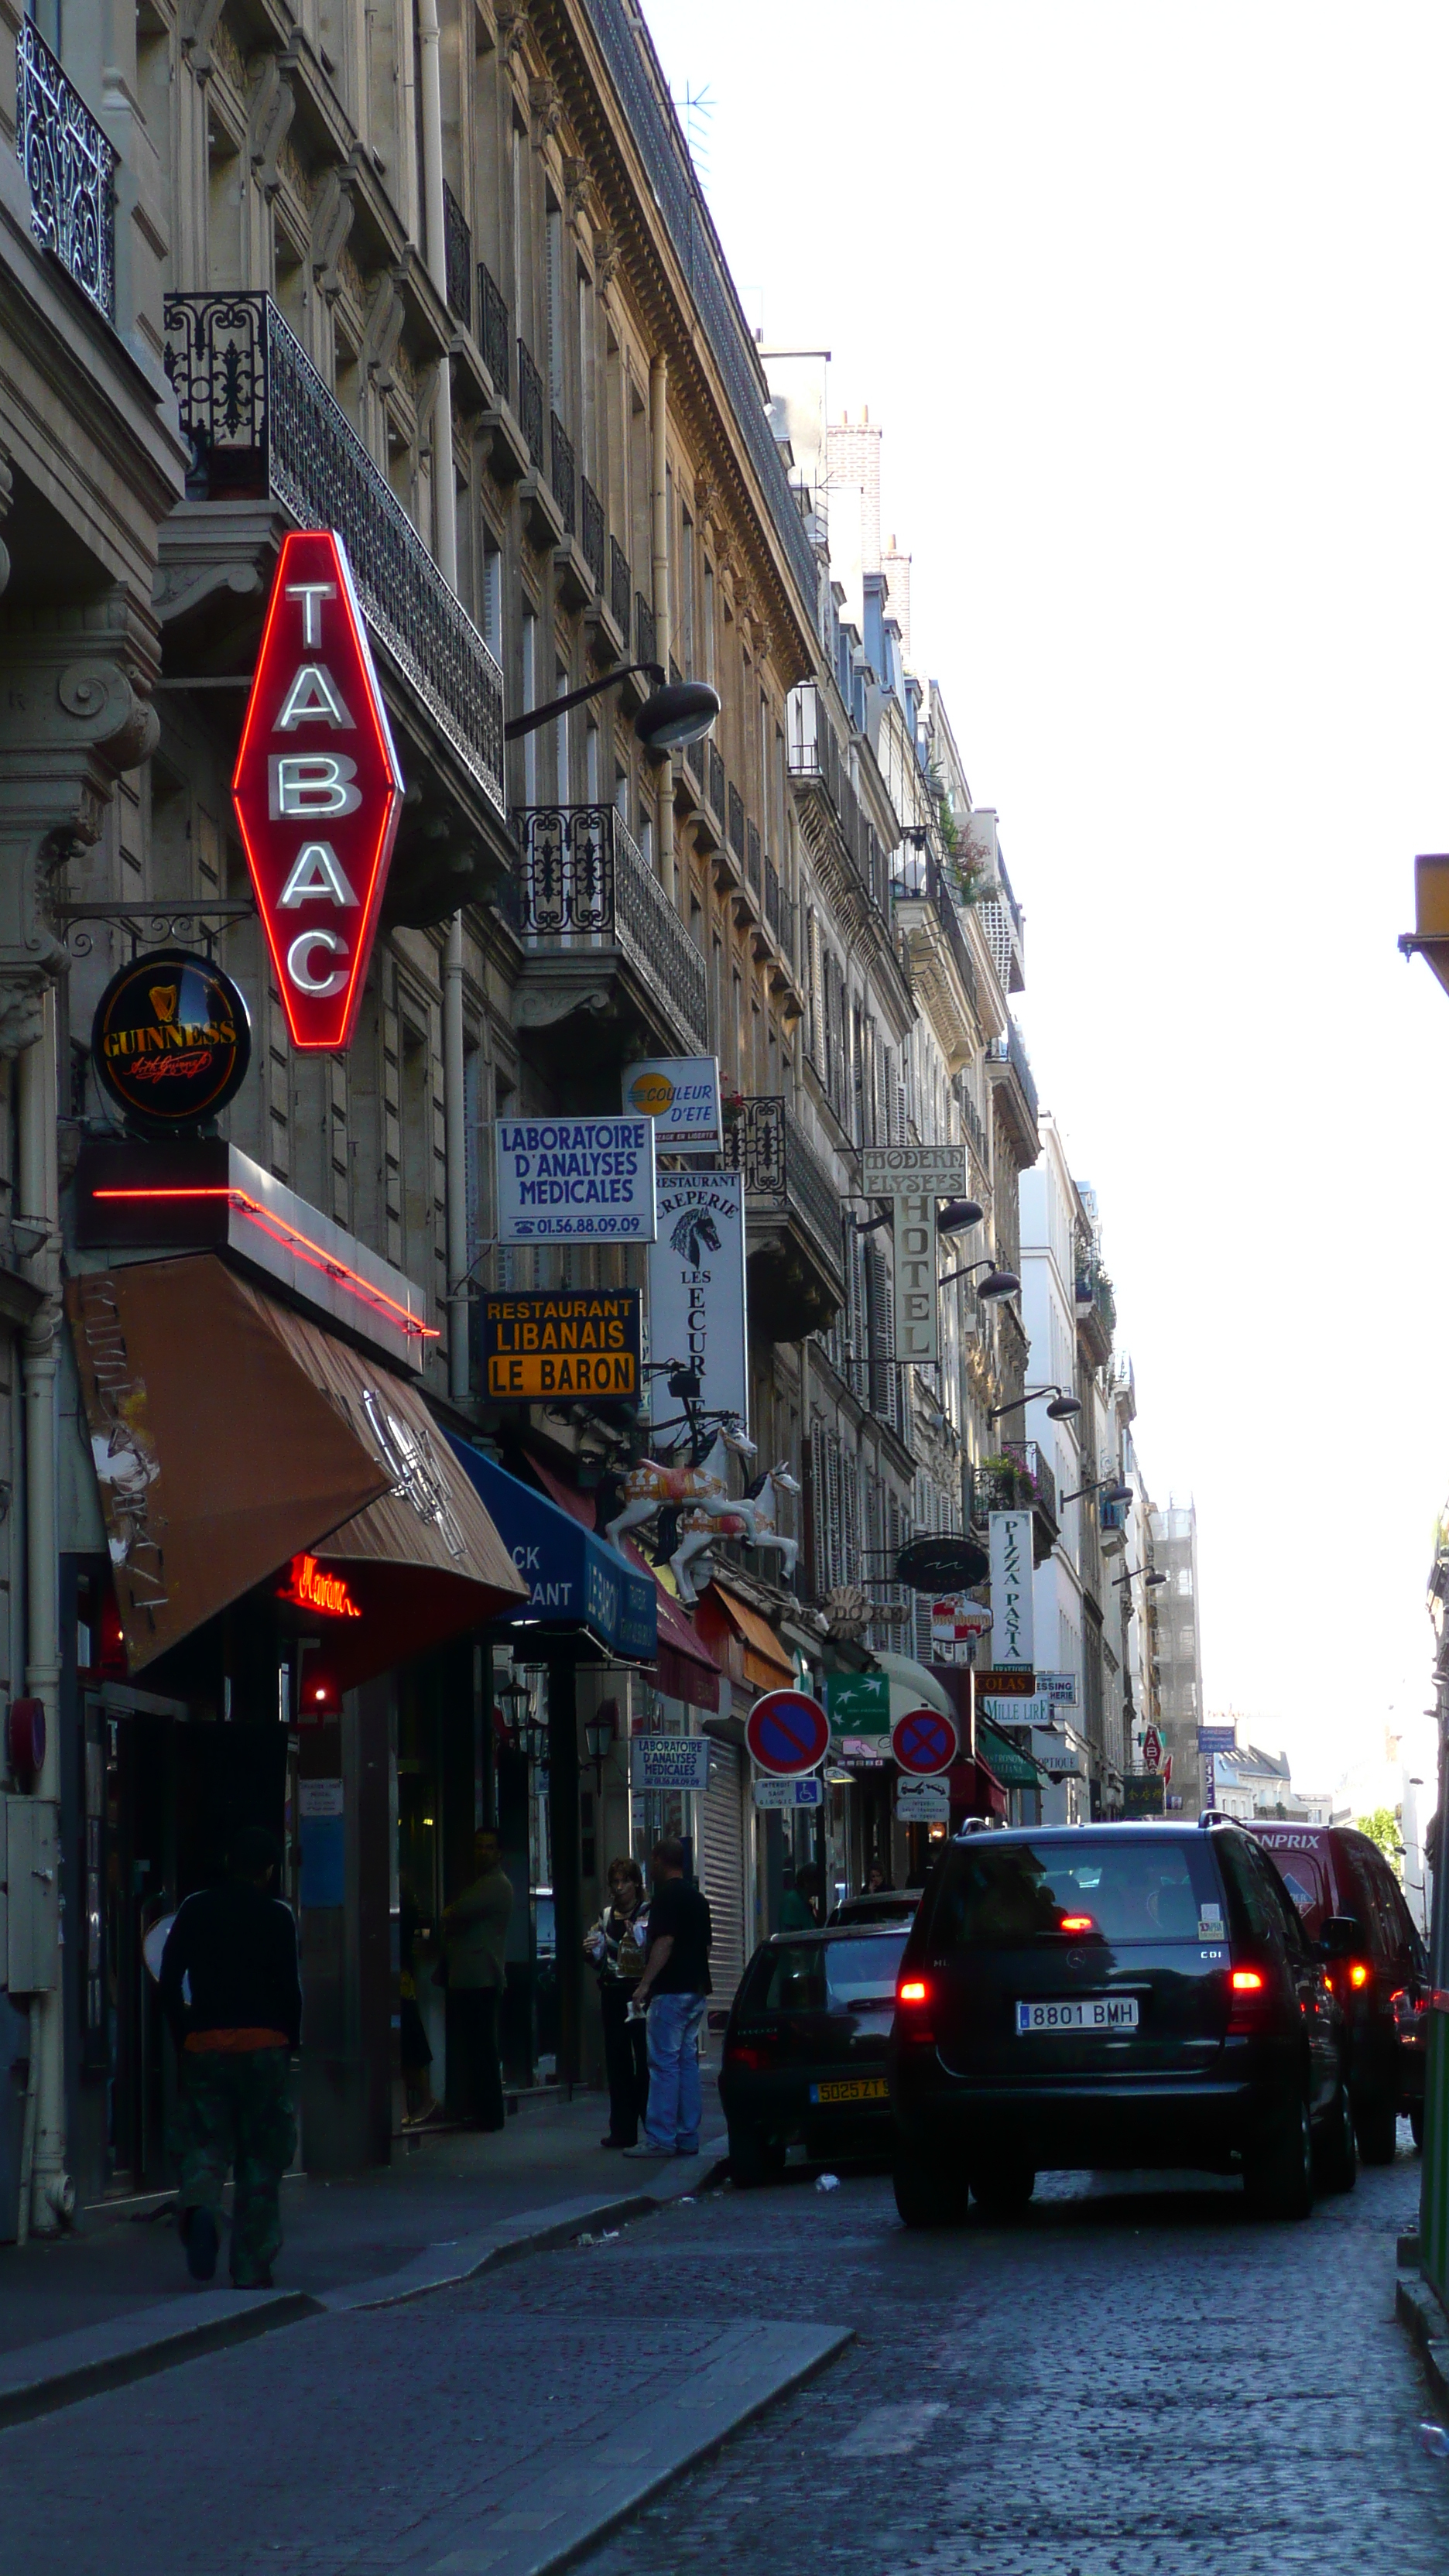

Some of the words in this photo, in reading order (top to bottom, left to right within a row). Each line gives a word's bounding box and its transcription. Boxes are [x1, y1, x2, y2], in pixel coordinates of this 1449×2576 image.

[268, 582, 363, 999] TABAC
[103, 1019, 237, 1057] GUINNESS
[646, 1085, 713, 1102] COULEUR
[670, 1105, 713, 1122] D'ETE
[501, 1123, 646, 1152] LABORATOIRE
[514, 1151, 639, 1178] D'ANALYSES
[864, 1150, 965, 1170] MODERN
[519, 1178, 634, 1205] MEDICALES
[865, 1173, 964, 1194] ELYSEES
[536, 1217, 640, 1235] 01.56.88.09.09
[681, 1270, 711, 1284] LES
[900, 1194, 930, 1355] HOTEL
[487, 1299, 633, 1320] RESTAURANT
[496, 1320, 625, 1351] LIBANAIS
[492, 1359, 524, 1392] LE
[540, 1357, 630, 1391] BARON
[1003, 1520, 1021, 1585] PIZZA
[1004, 1593, 1022, 1658] PASTA
[986, 1700, 1019, 1720] MILLE
[1024, 1699, 1048, 1720] LIRE
[638, 1740, 703, 1753] LABORATOIRE
[642, 1752, 697, 1764] D'ANALYSES
[645, 1764, 696, 1776] MEDICALES
[1256, 1834, 1321, 1849] NPRIX
[1201, 1951, 1222, 1959] CDI
[1033, 2005, 1084, 2026] 8801
[1093, 2003, 1133, 2024] BMH
[820, 2080, 859, 2101] 5025
